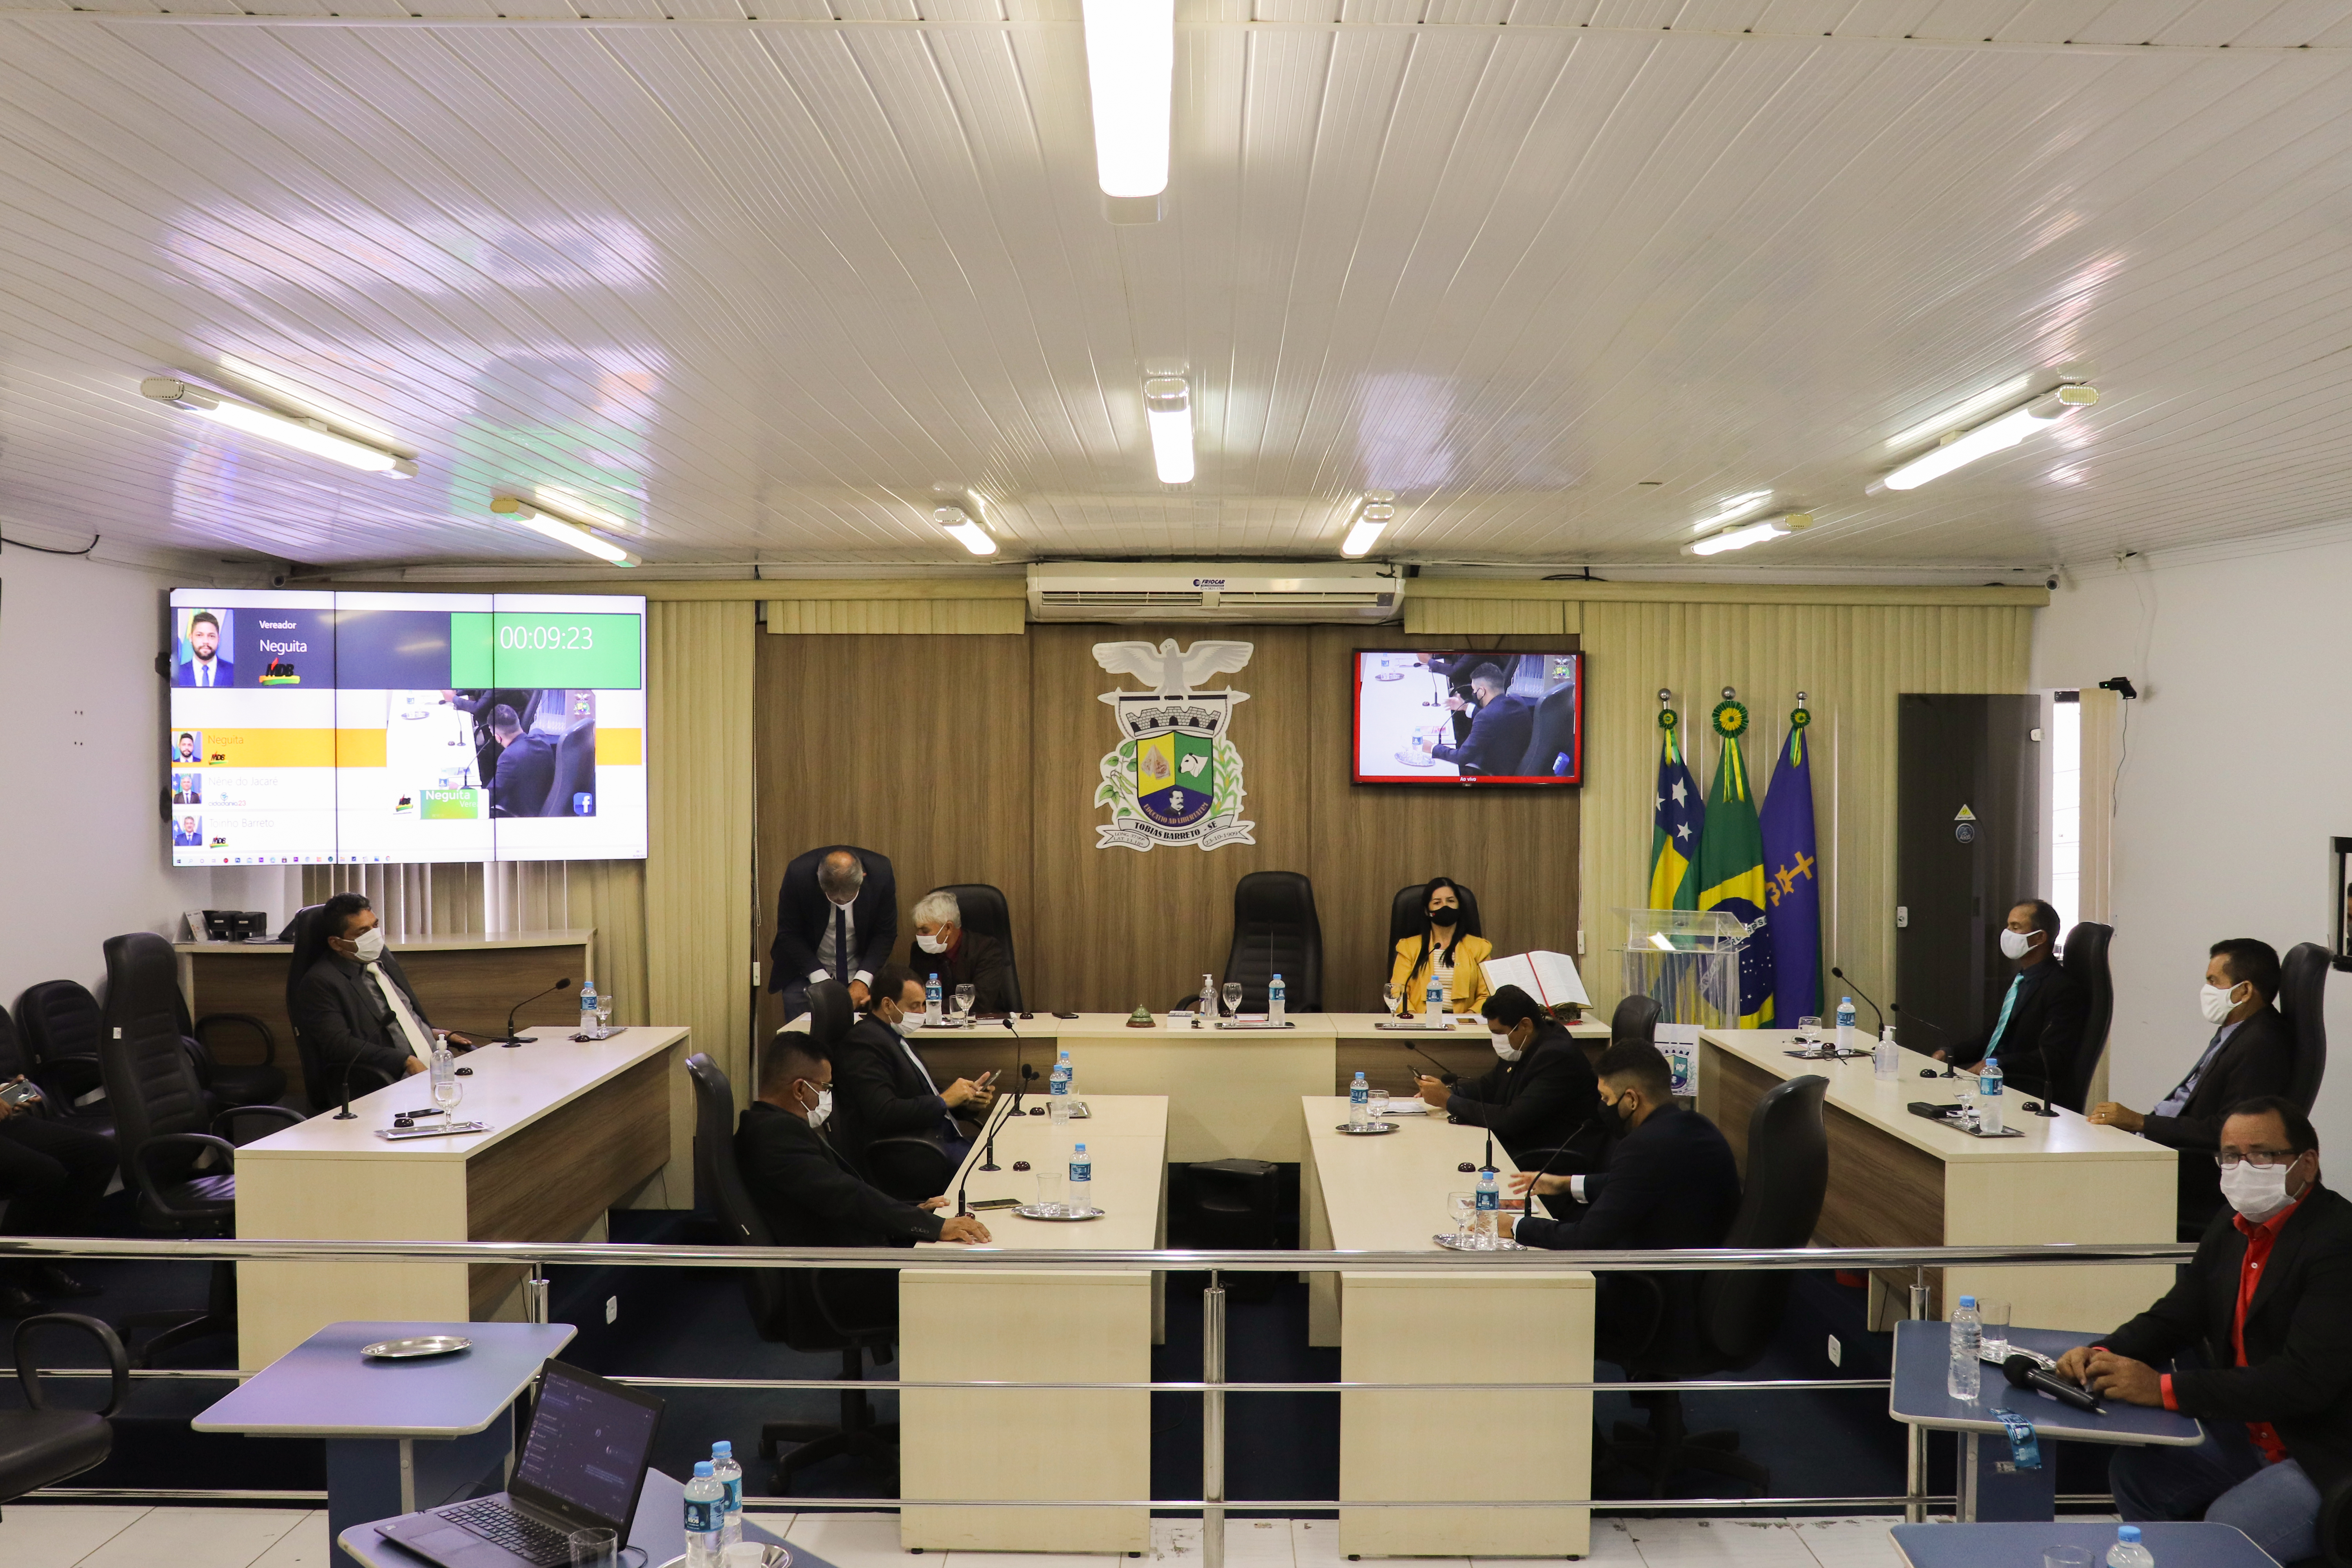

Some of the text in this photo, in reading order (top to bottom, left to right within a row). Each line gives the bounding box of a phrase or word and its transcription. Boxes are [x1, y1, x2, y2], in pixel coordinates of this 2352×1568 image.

[259, 620, 297, 629] Vereador
[500, 626, 593, 649] 00:09:23
[260, 639, 307, 655] Neguita
[265, 663, 294, 677] MDB
[208, 735, 243, 746] Neguita
[209, 777, 278, 786] Nêne do Jacaré
[426, 789, 470, 802] Neguita
[1143, 804, 1168, 823] EDUCATIO
[1178, 802, 1209, 824] LIBERTATEM
[209, 818, 274, 828] Toinho Barreto
[1135, 822, 1163, 837] TOBIAS
[1163, 829, 1200, 840] BARRETO
[1207, 821, 1218, 830] SE
[1205, 831, 1238, 846] 23-10-1909
